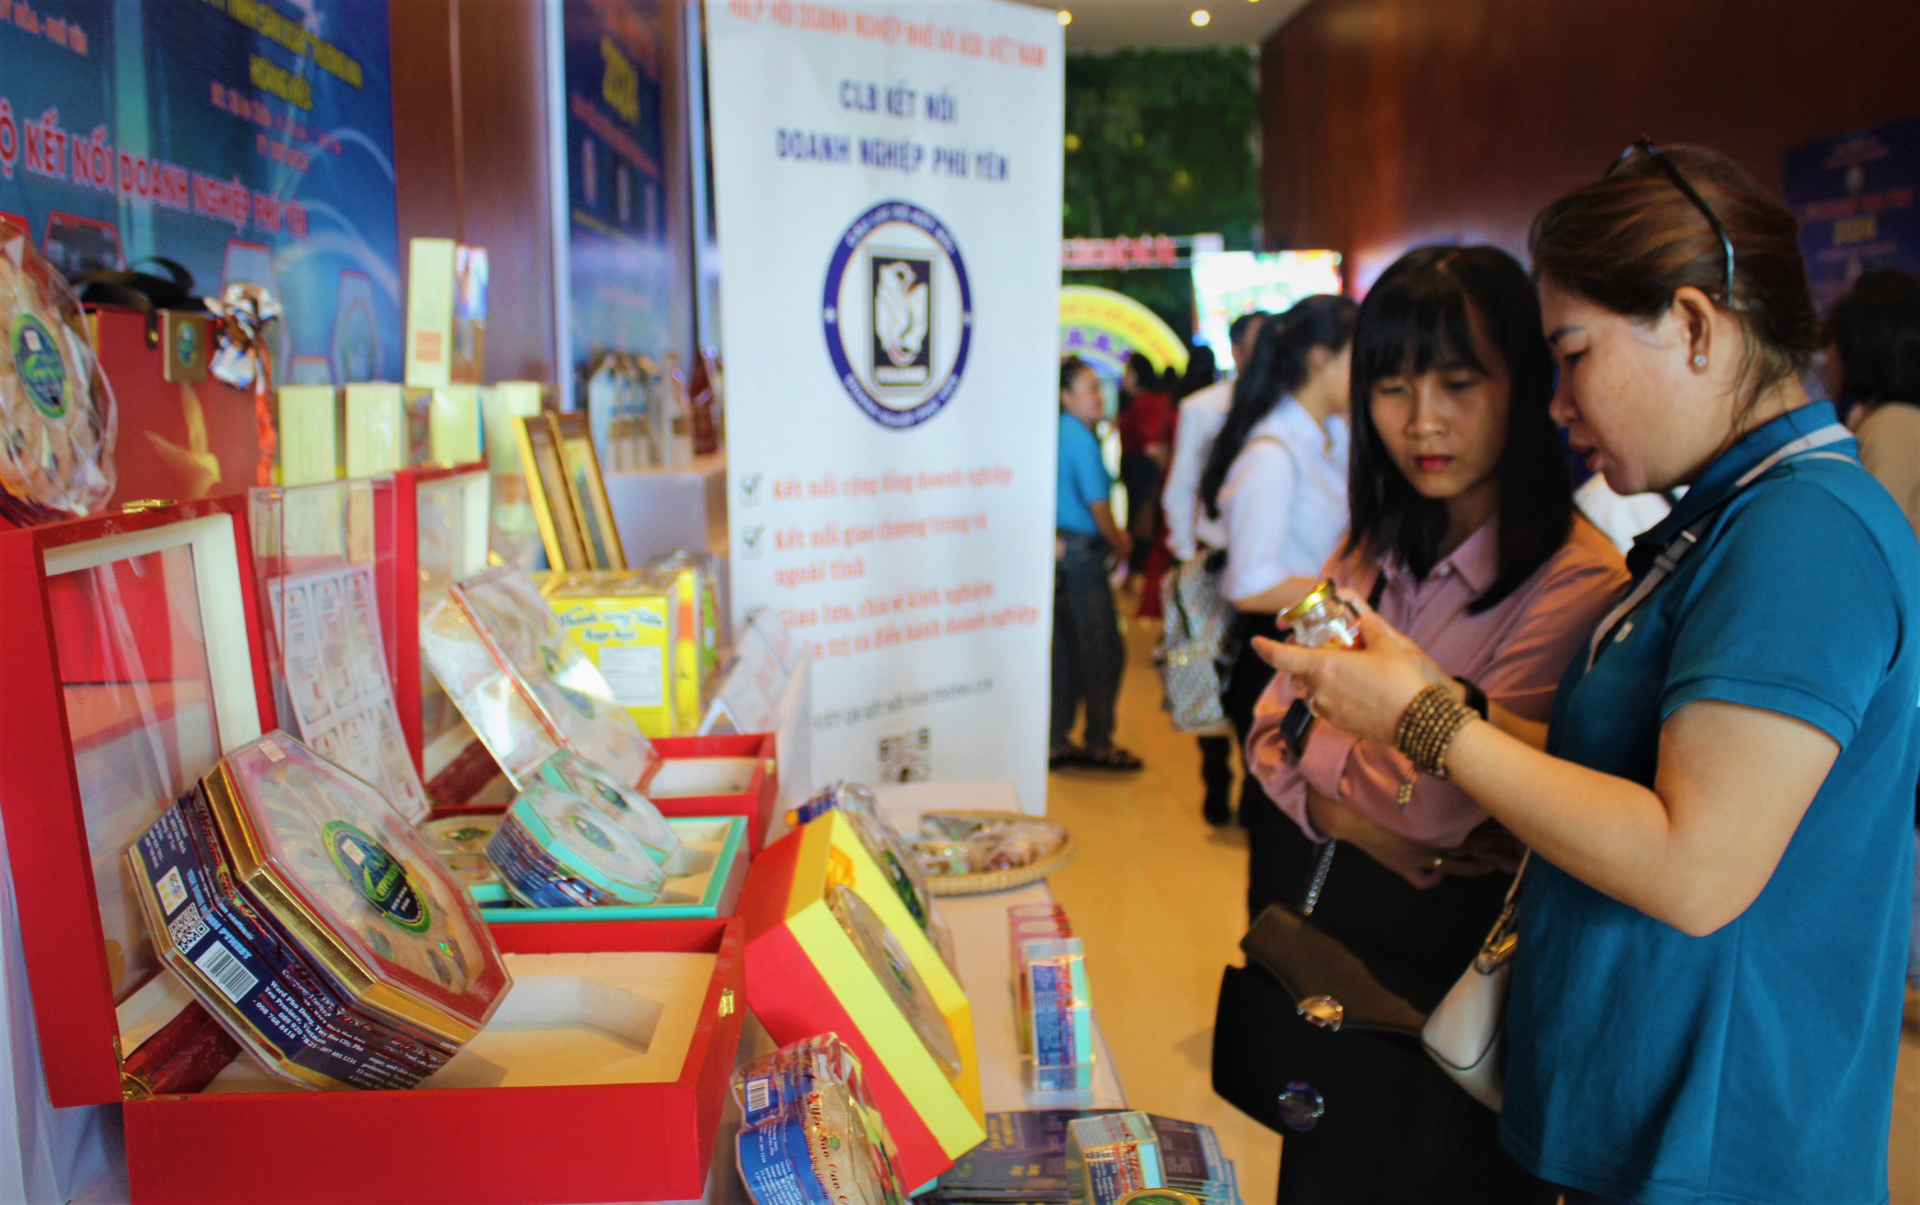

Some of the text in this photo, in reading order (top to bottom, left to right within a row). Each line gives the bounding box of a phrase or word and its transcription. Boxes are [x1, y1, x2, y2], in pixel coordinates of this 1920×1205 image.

[840, 78, 959, 123] CLB KẾT NỐI
[24, 107, 67, 179] KẾT
[71, 124, 115, 191] NỐI
[119, 151, 189, 209] DOANH
[191, 173, 250, 235] NGHIỆP
[776, 128, 1010, 183] DOANH NGHIỆP PHÚ YÊN
[773, 473, 802, 501] Kết
[808, 473, 838, 498] nối
[917, 468, 962, 490] doanh
[774, 524, 804, 552] Kết
[810, 521, 839, 549] nối
[844, 523, 876, 549] giao
[776, 560, 825, 588] ngoài
[908, 587, 940, 608] kinh
[945, 613, 986, 635] doanh
[217, 926, 252, 959] PYNEST
[255, 1001, 269, 1015] 098
[267, 1012, 280, 1026] 768
[278, 1022, 296, 1039] 8418
[263, 985, 327, 1046] Yen Province, Vietnam
[269, 979, 288, 999] Ward
[285, 995, 300, 1010] Phu
[297, 1006, 316, 1027] Dong,
[314, 1024, 327, 1038] Tuy
[277, 1011, 292, 1025] 089
[289, 1022, 303, 1035] 920
[828, 1163, 841, 1190] Cao
